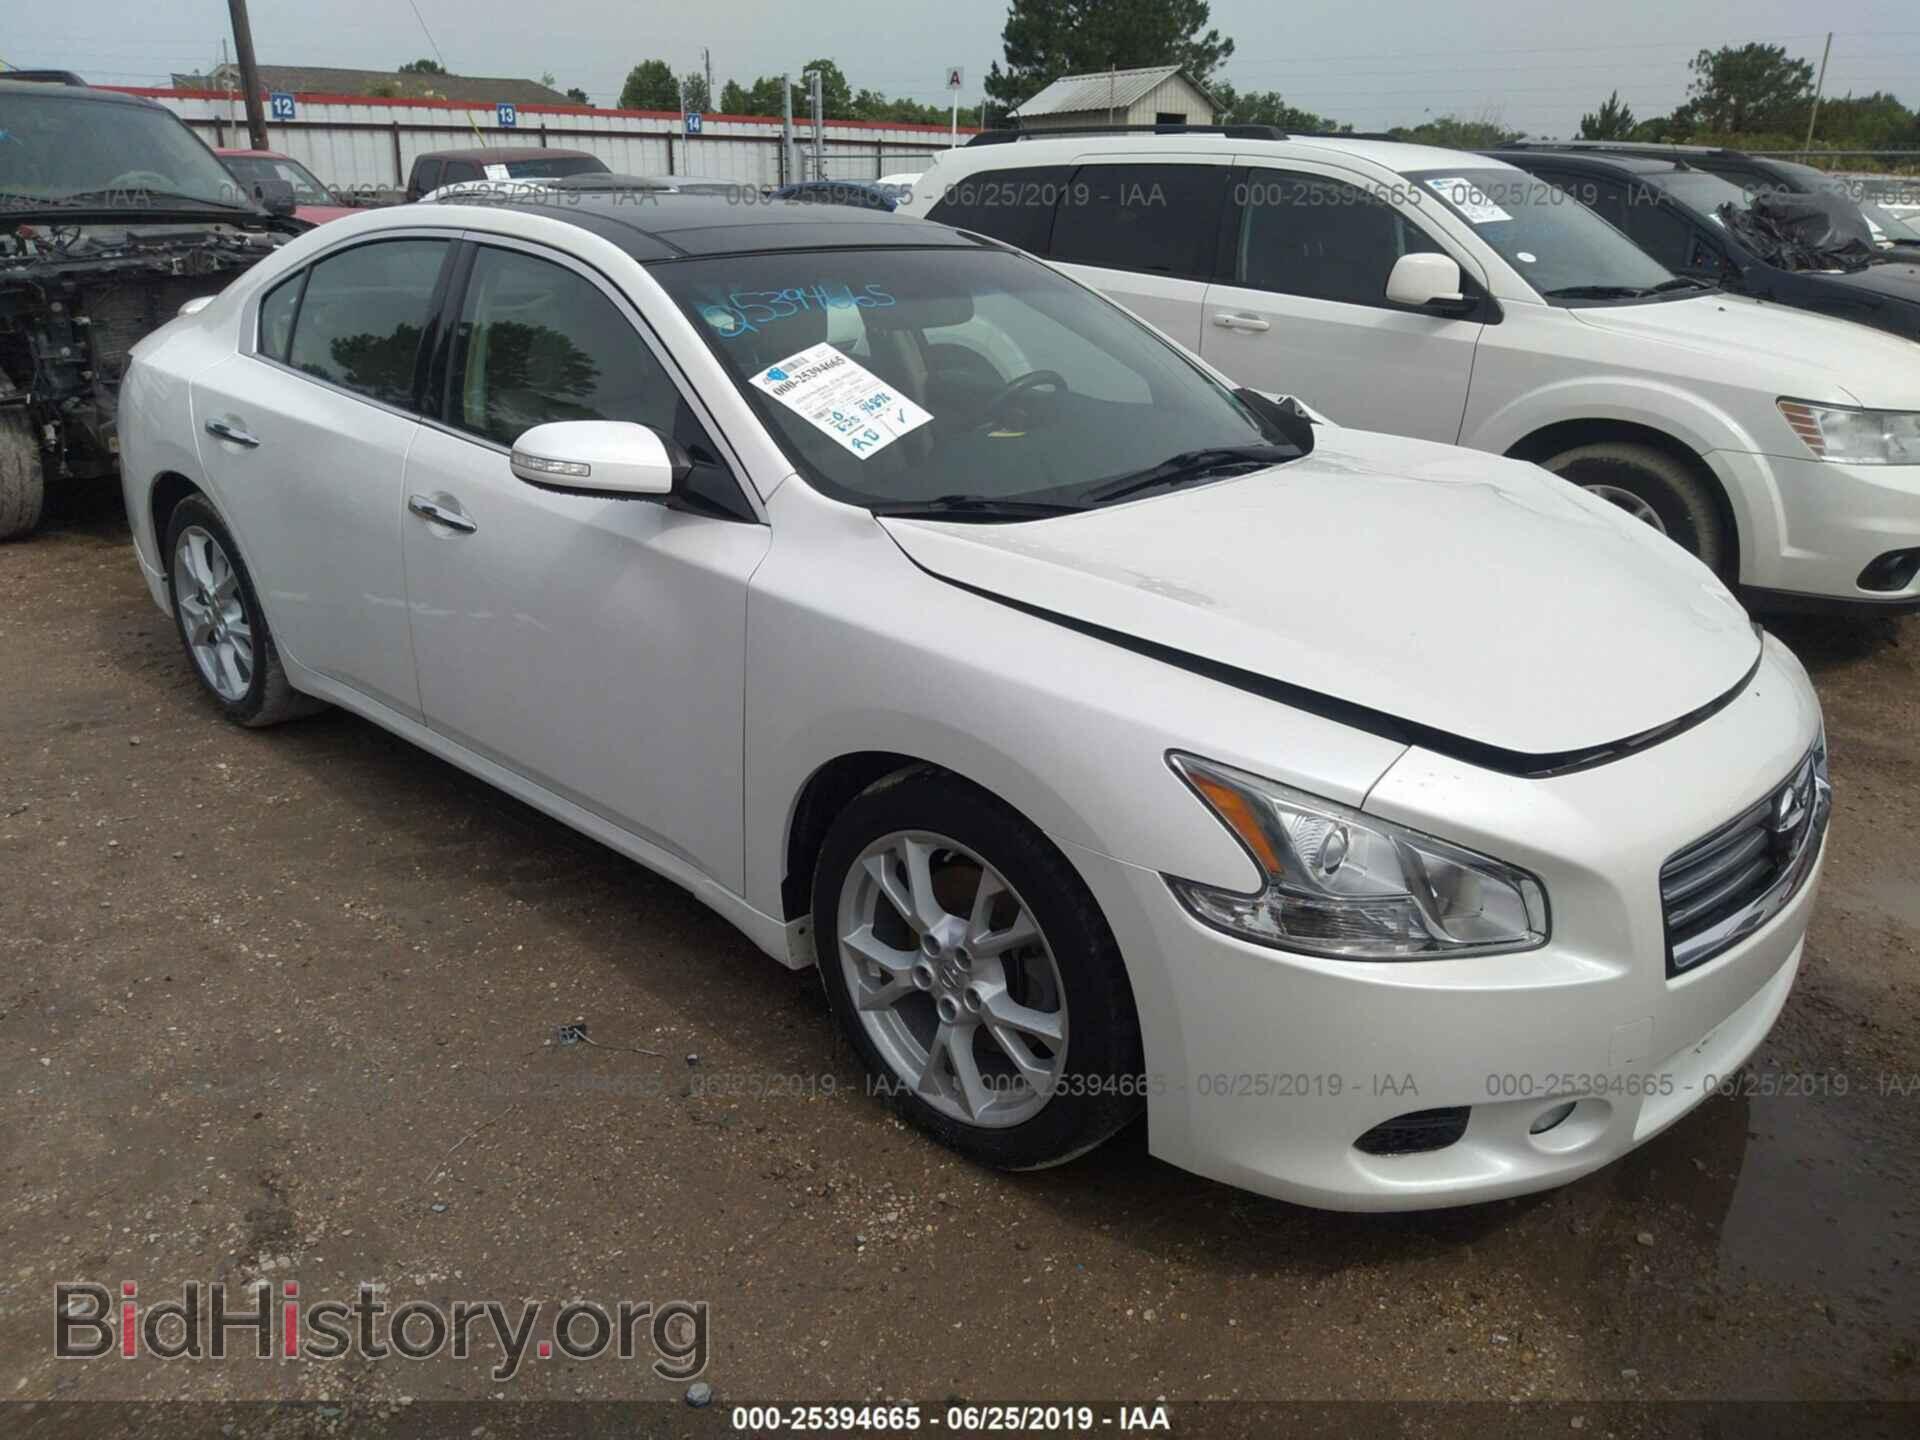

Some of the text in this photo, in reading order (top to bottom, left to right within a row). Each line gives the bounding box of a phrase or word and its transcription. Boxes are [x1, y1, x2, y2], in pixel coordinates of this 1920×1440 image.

[950, 70, 961, 86] A
[275, 97, 293, 115] 12
[499, 106, 514, 123] 13
[687, 117, 700, 131] 14
[772, 355, 847, 397] 000-25394665
